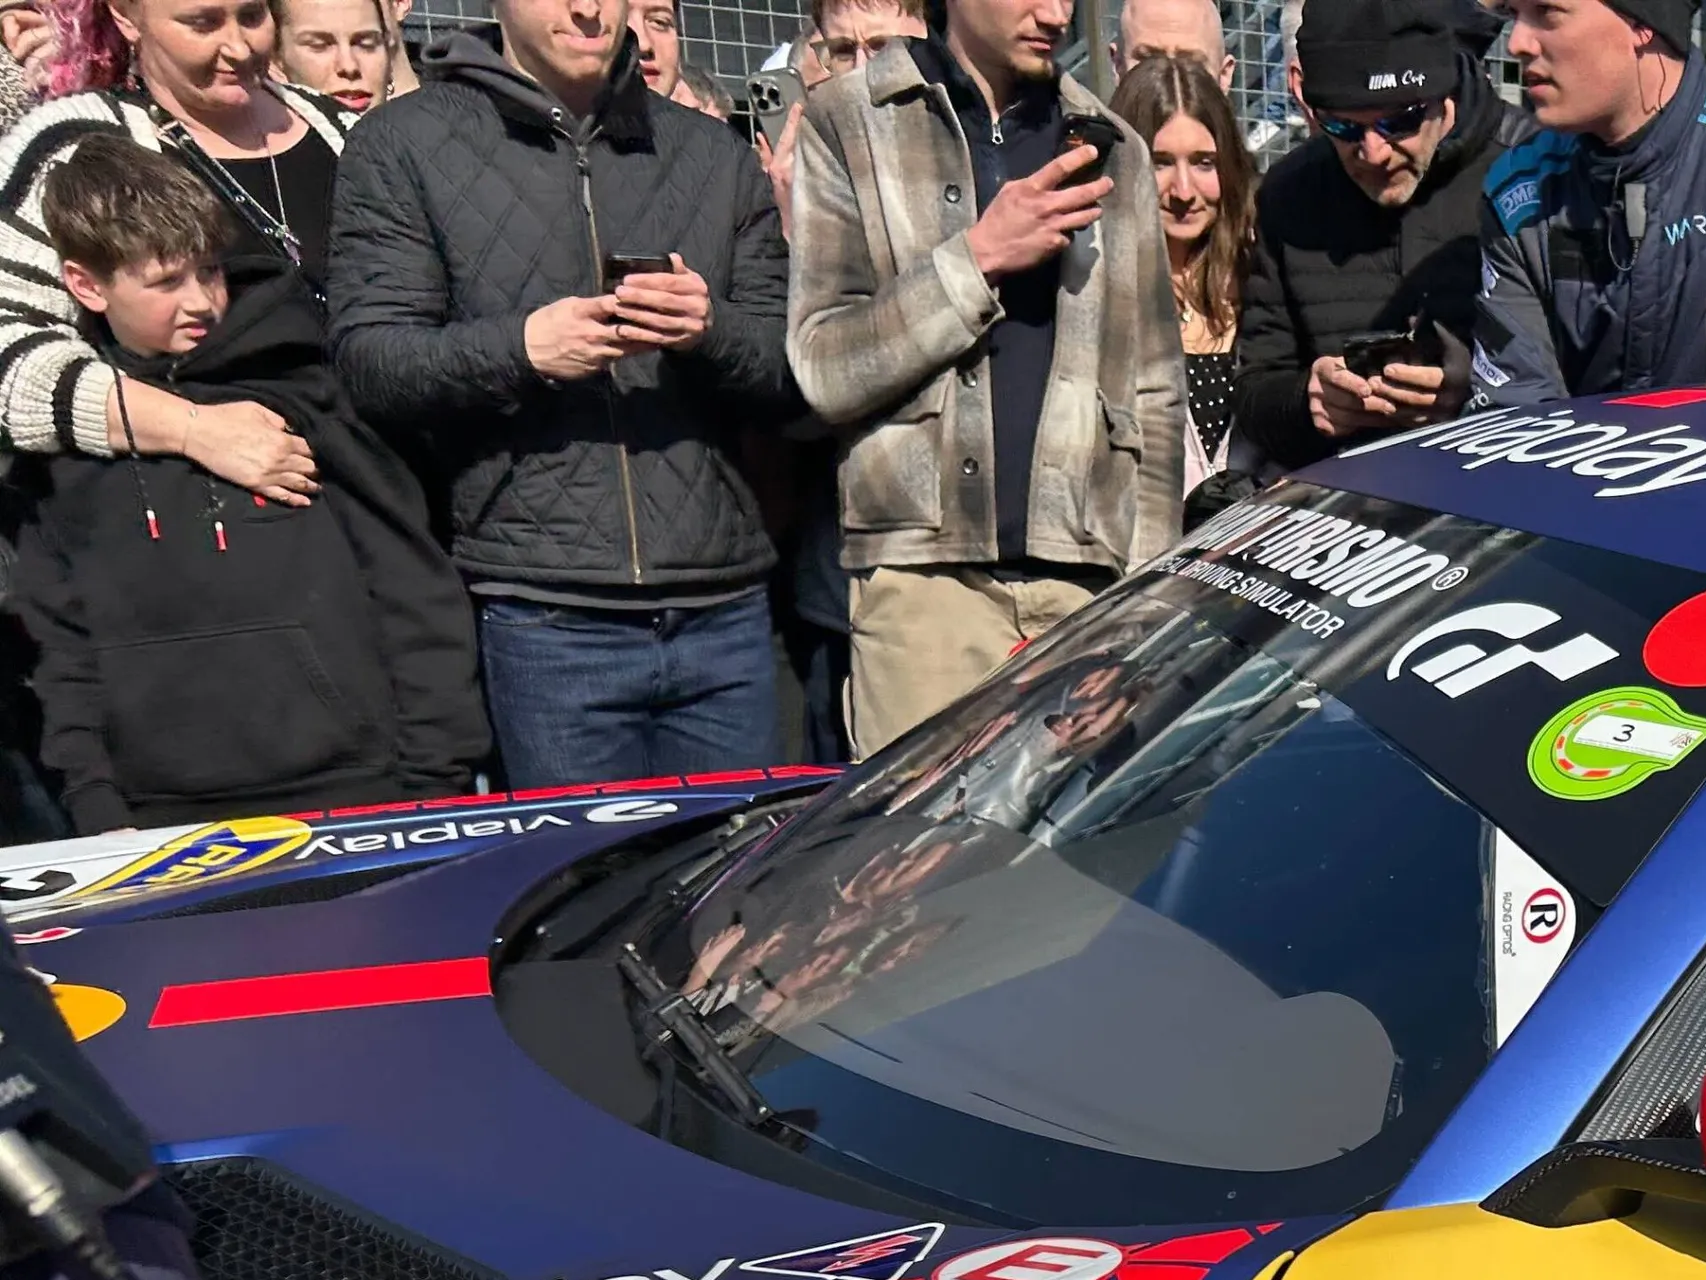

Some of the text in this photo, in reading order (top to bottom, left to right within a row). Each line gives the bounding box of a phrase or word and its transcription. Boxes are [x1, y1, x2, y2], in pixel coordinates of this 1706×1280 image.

[1230, 577, 1345, 639] SIMULATOR
[1613, 723, 1636, 743] 3
[294, 813, 572, 860] viaplay
